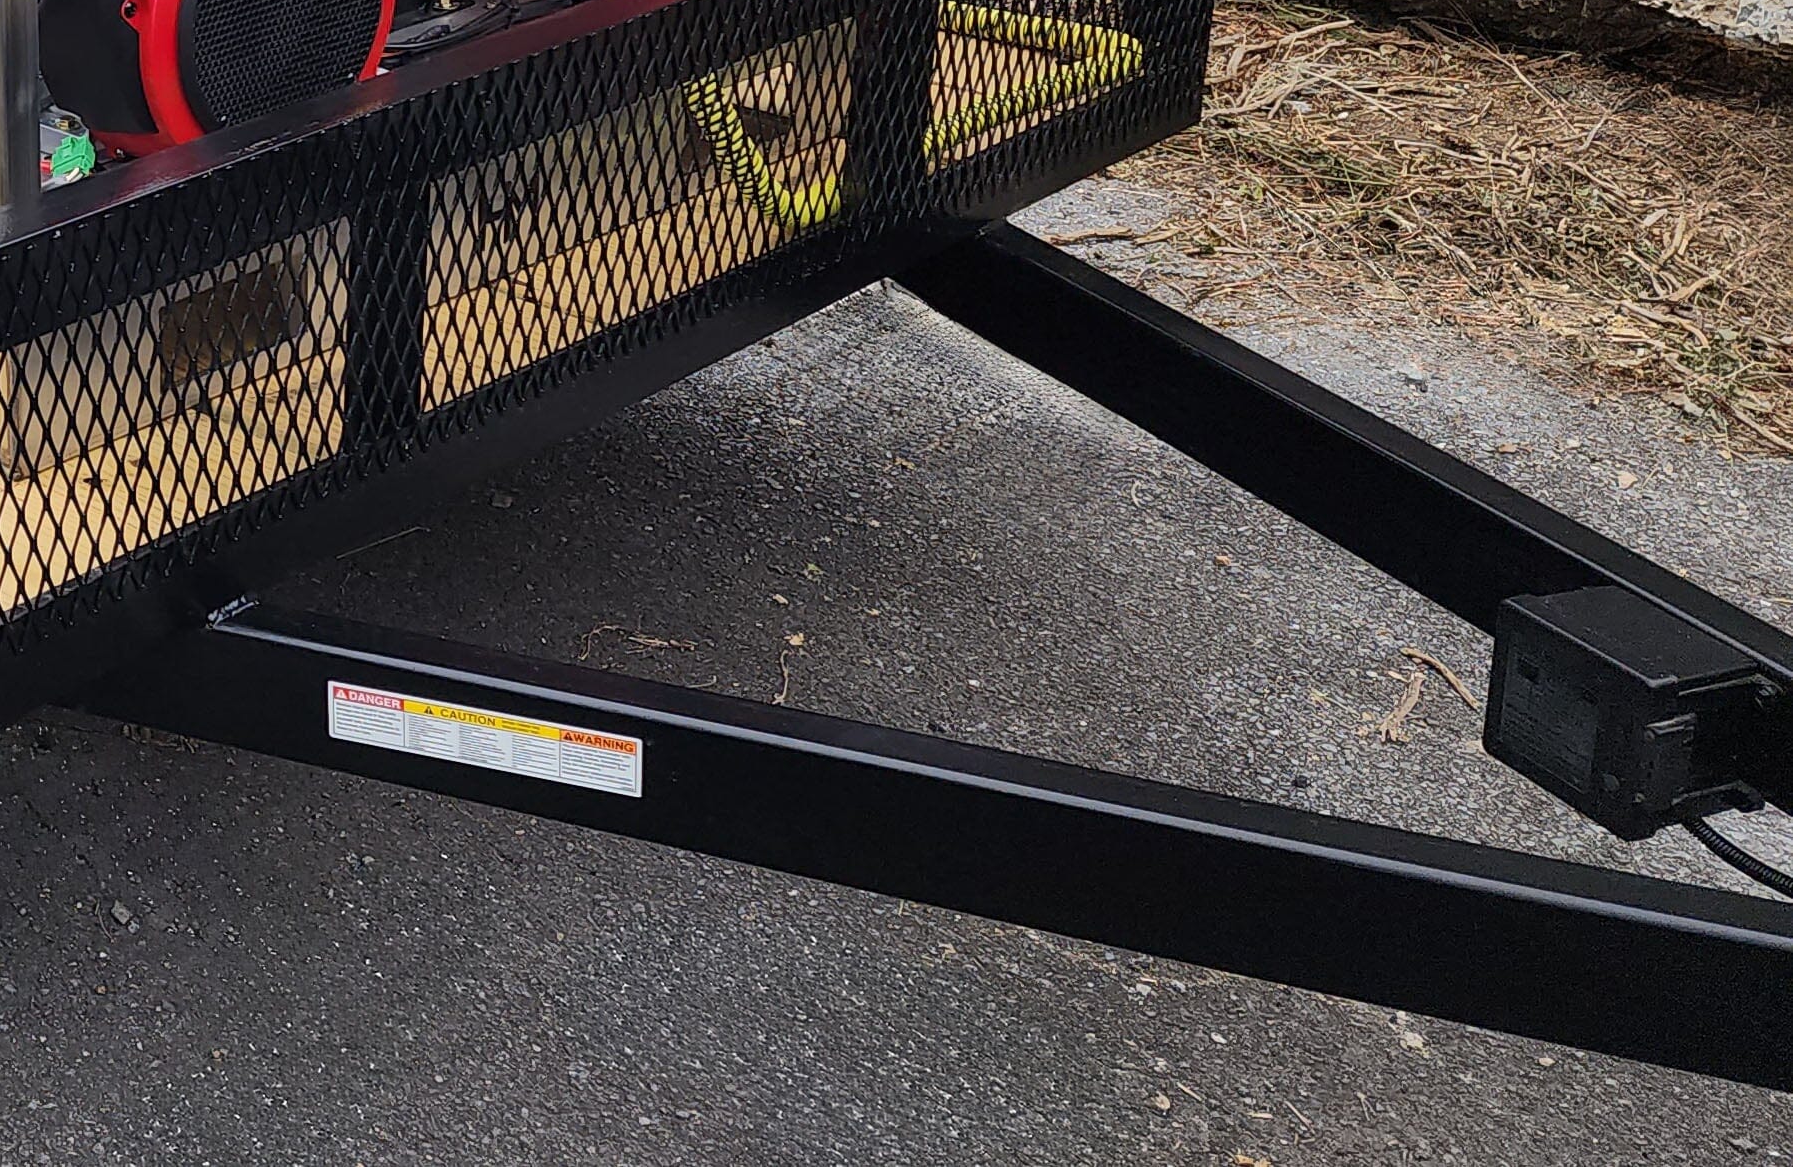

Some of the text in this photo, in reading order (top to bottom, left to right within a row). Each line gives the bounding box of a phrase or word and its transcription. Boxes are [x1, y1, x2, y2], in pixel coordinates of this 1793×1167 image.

[348, 691, 401, 710] DANGER
[440, 709, 496, 727] CAUTION
[573, 732, 635, 753] WARNING
